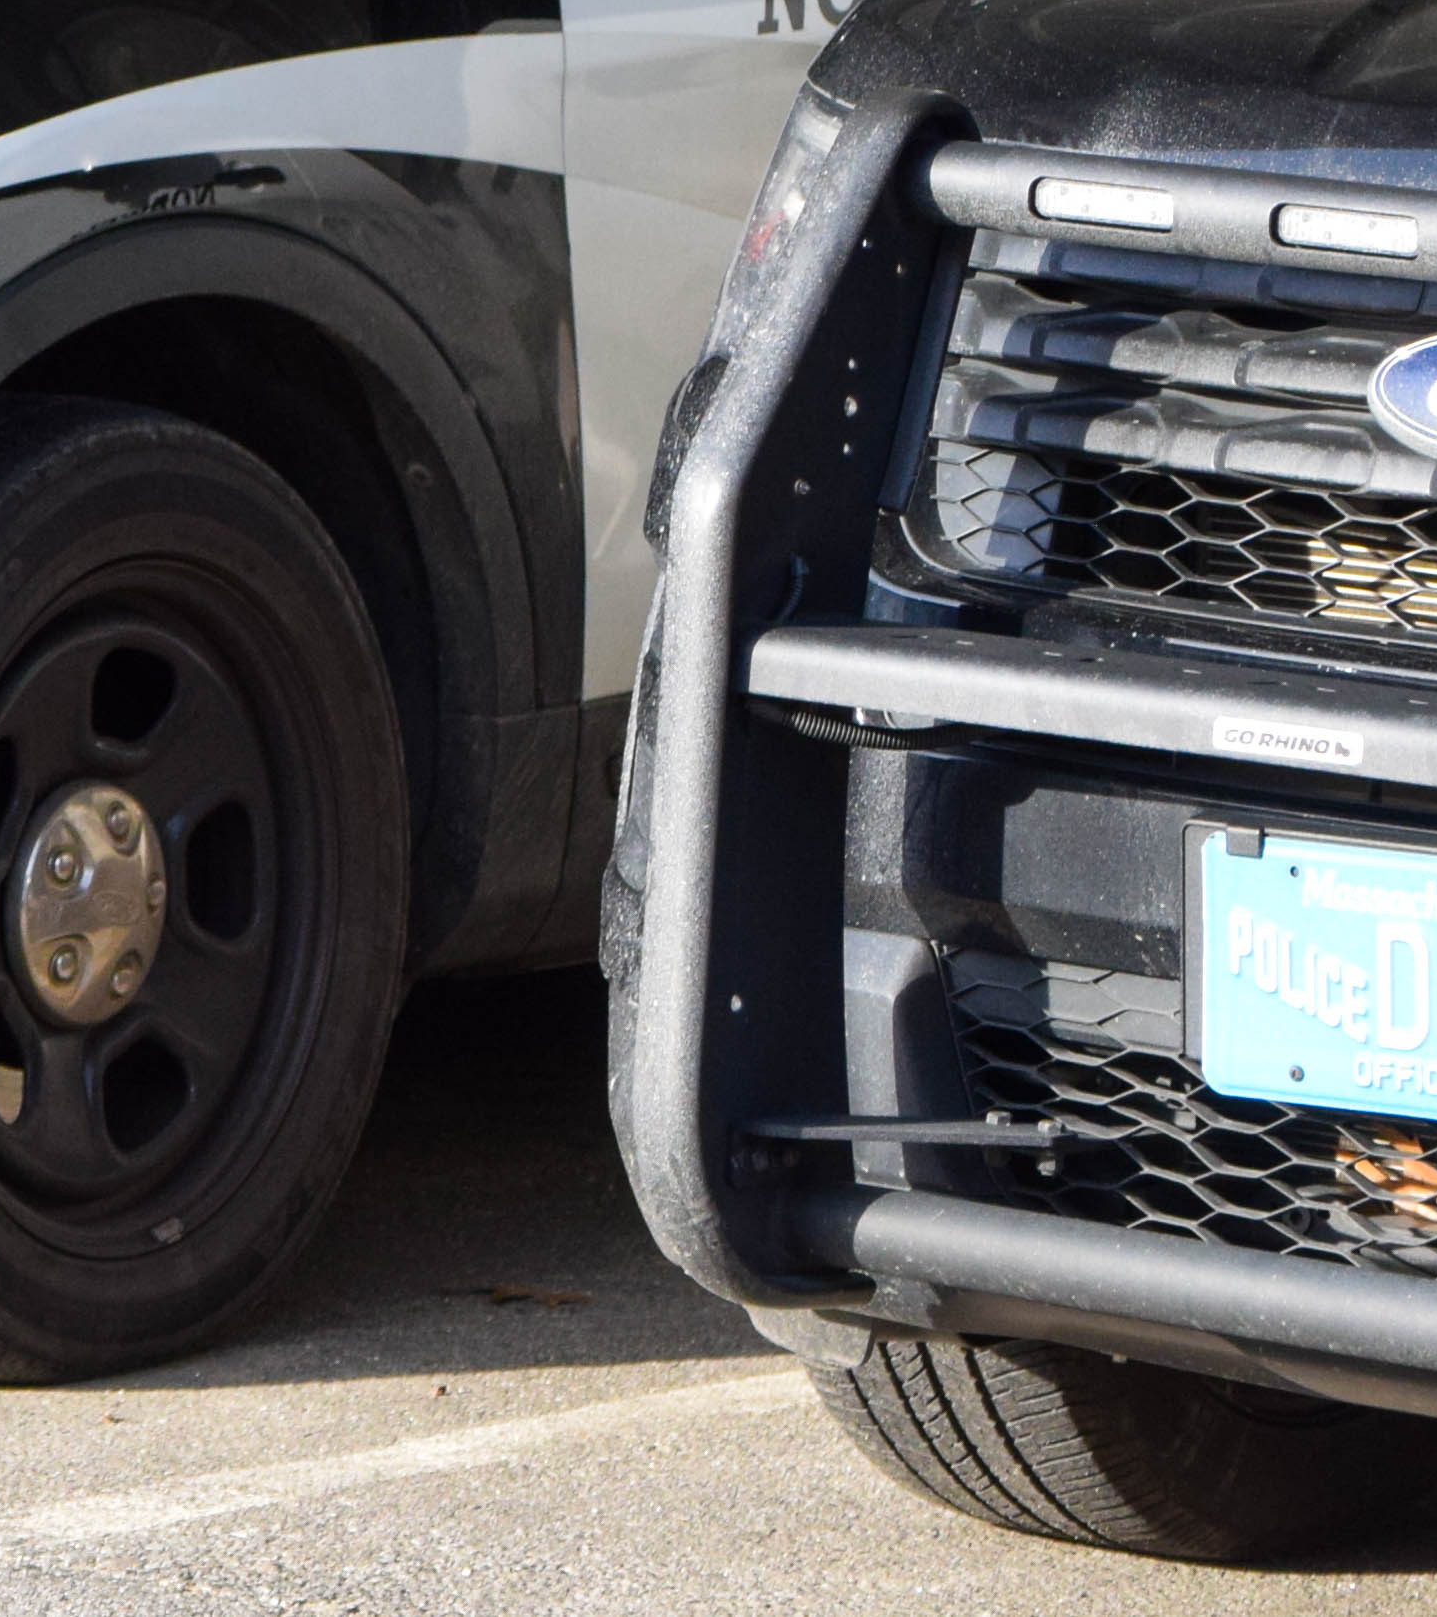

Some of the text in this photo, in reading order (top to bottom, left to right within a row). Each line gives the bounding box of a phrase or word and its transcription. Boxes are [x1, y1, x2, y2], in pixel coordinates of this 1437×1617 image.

[1225, 729, 1330, 754] GO RHINO
[1229, 905, 1370, 1044] POLICE
